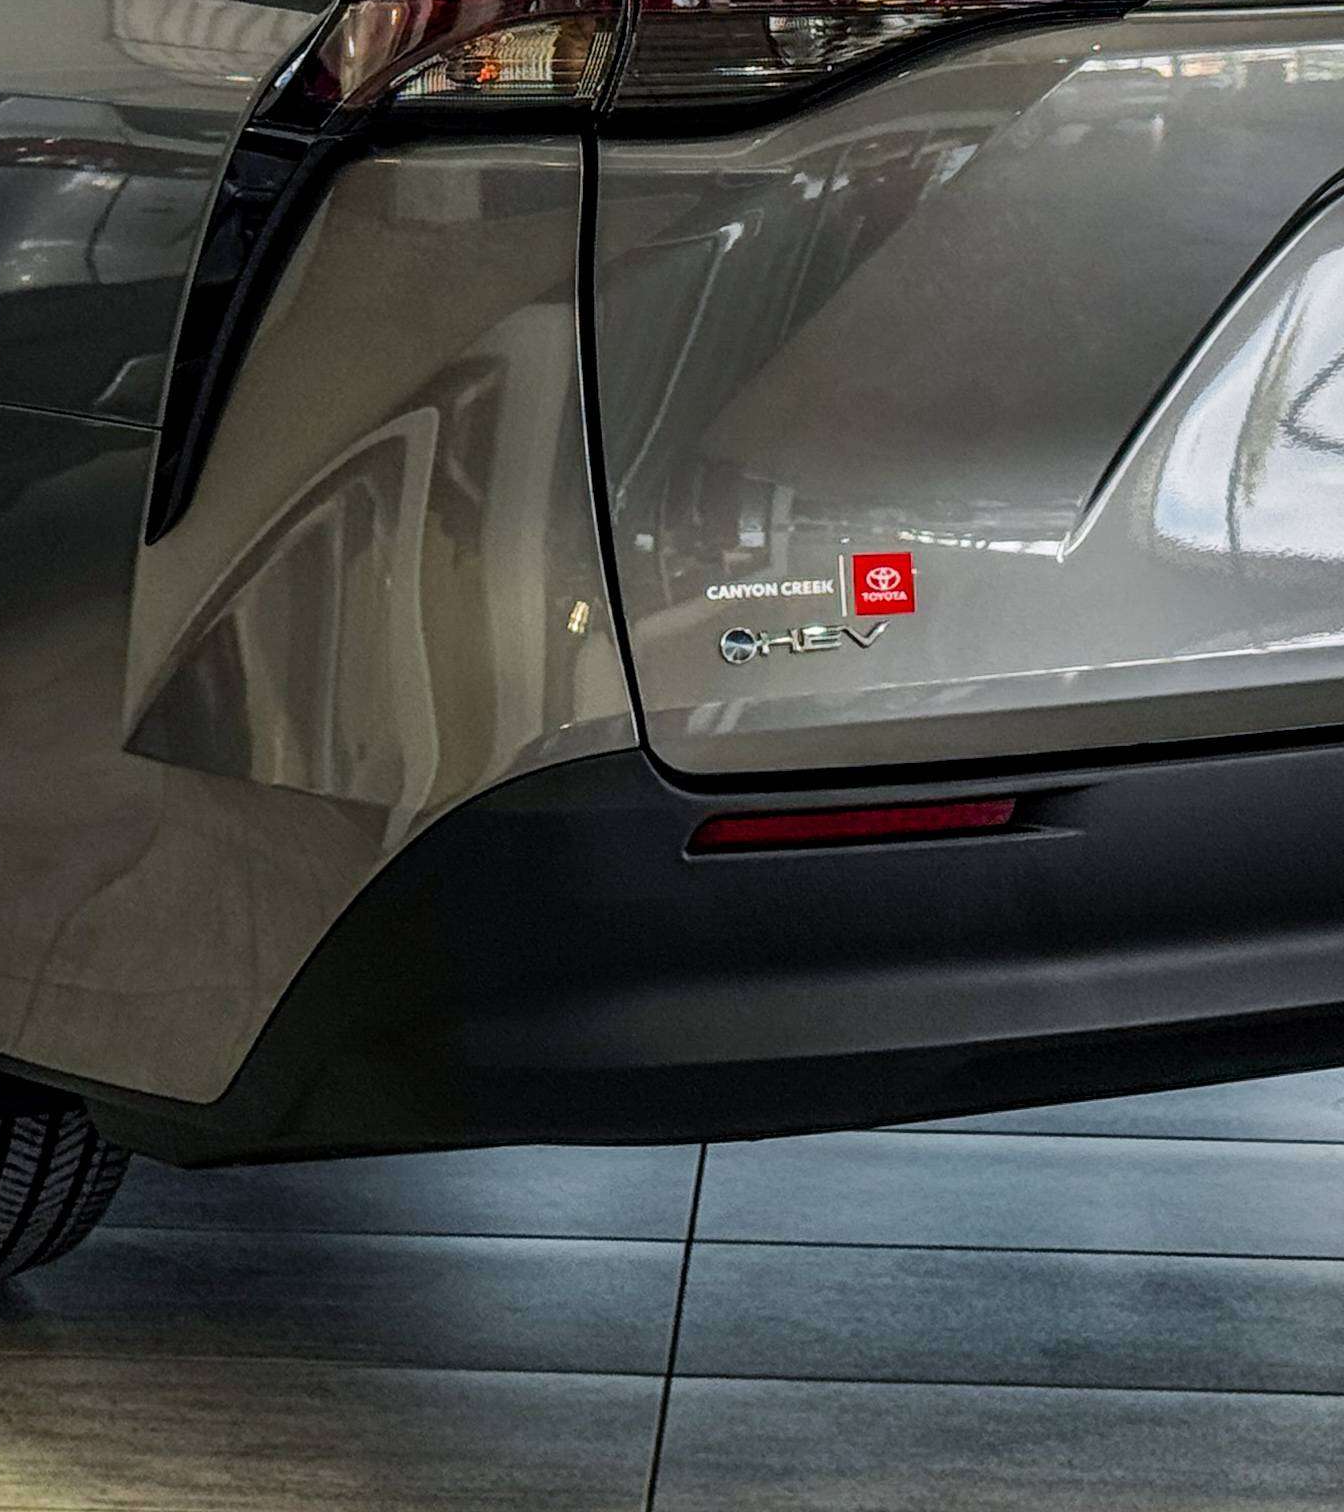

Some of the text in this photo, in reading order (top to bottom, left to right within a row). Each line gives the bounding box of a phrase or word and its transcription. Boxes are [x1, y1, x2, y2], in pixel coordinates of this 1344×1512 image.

[706, 579, 834, 601] CANYON CREEK
[860, 591, 909, 603] TOYOTA
